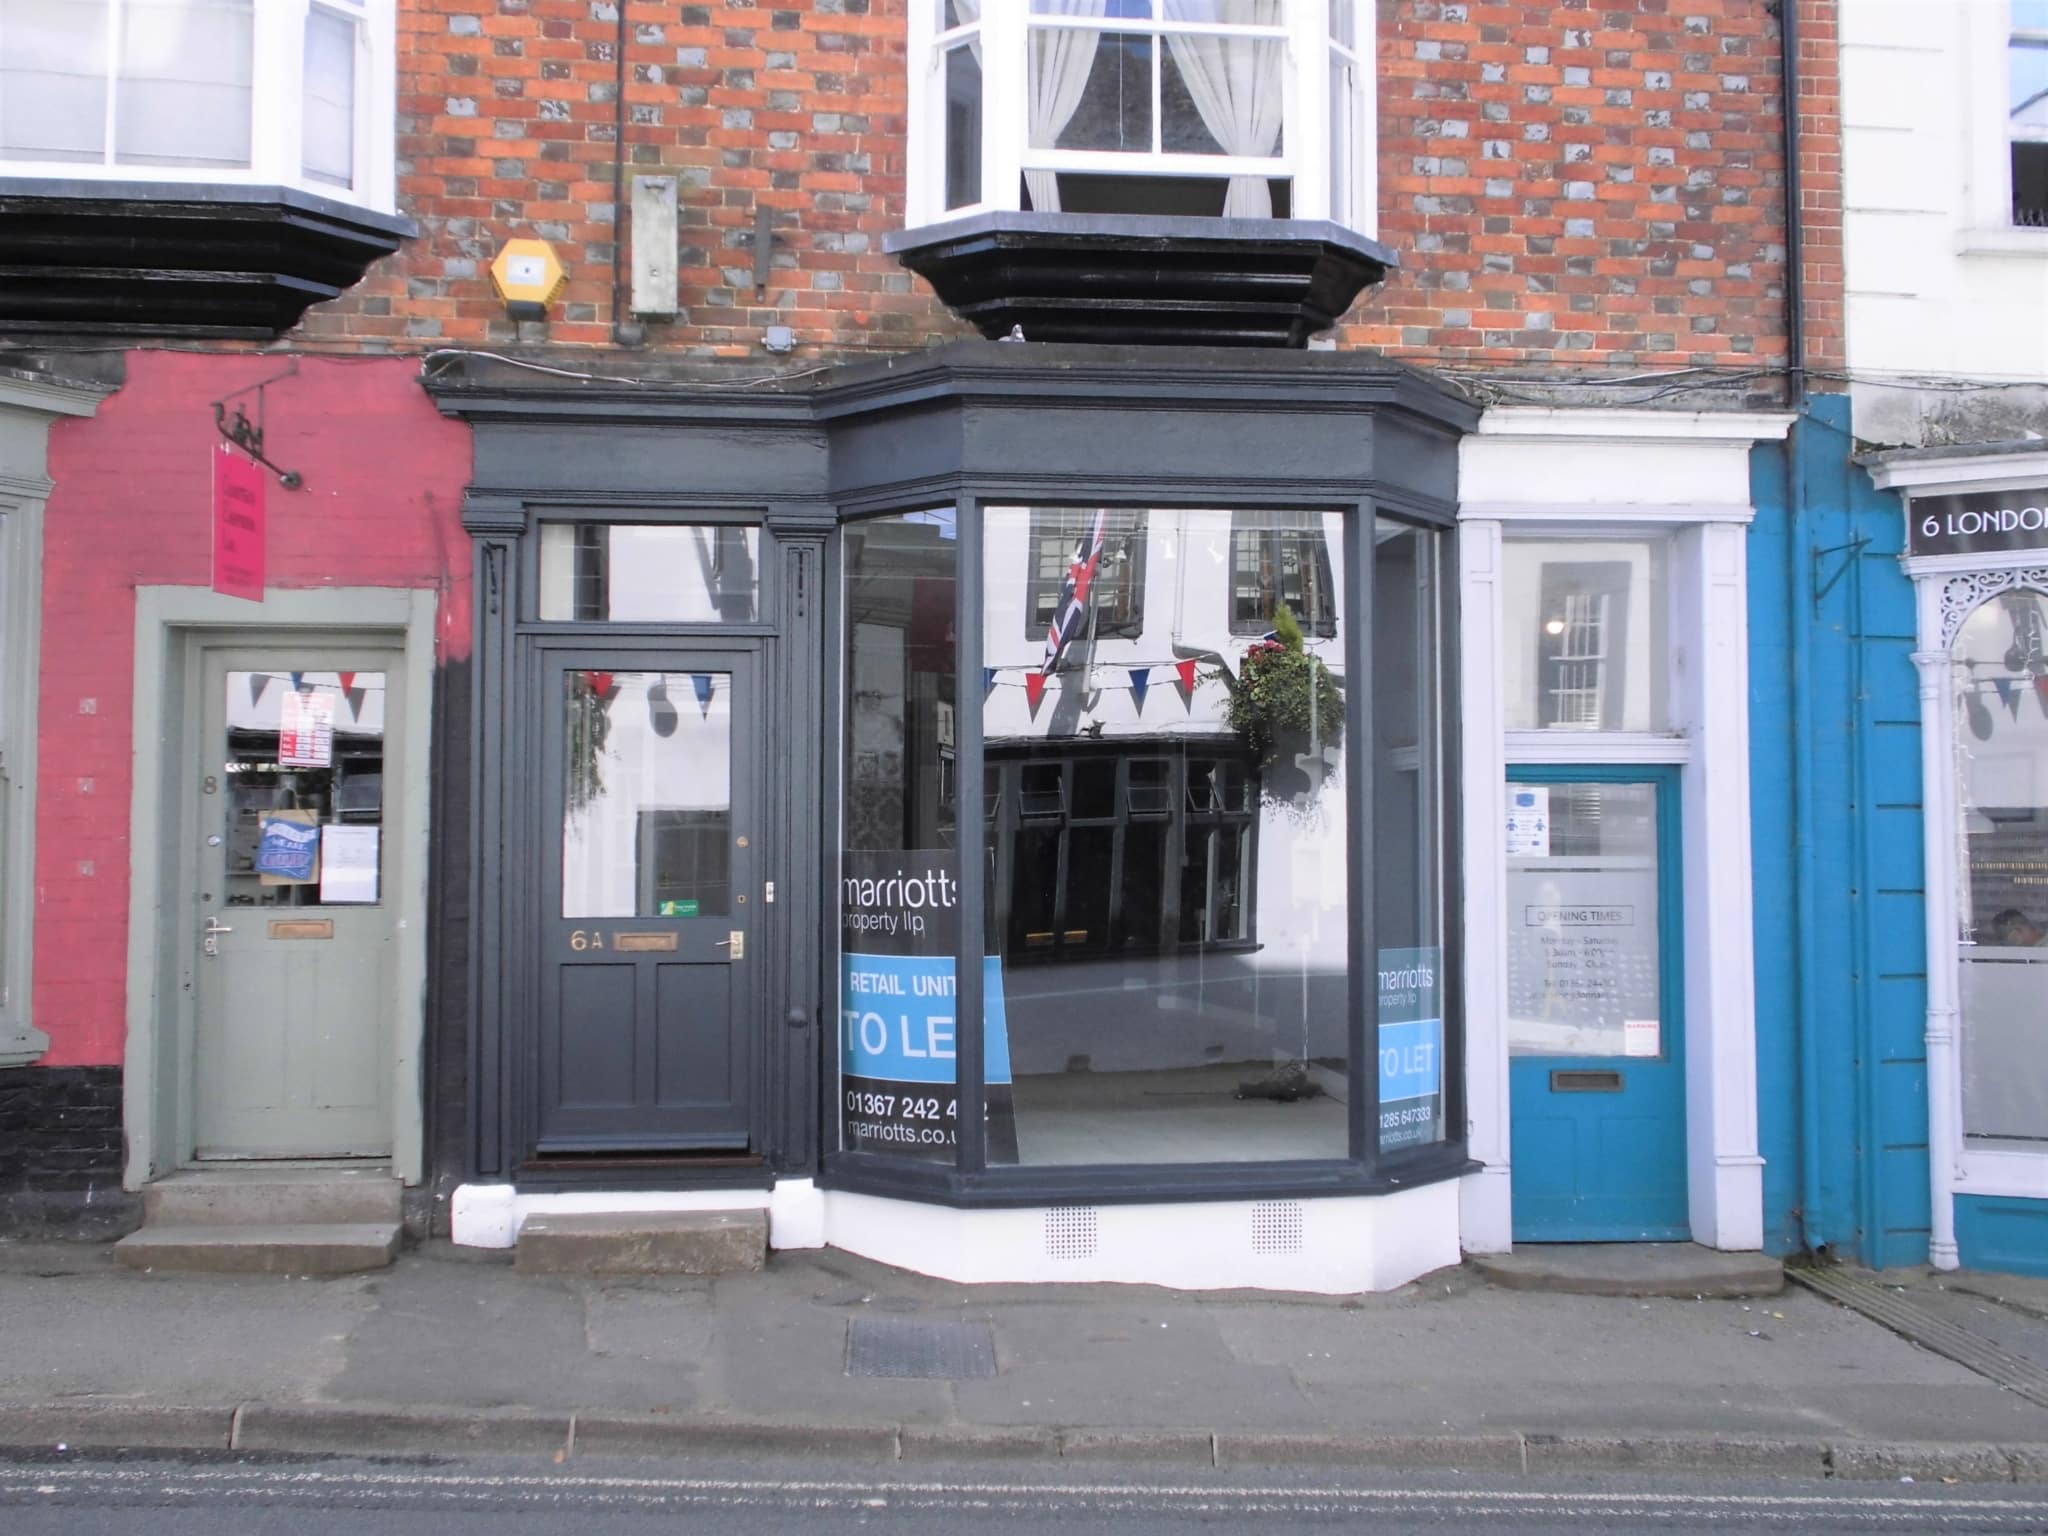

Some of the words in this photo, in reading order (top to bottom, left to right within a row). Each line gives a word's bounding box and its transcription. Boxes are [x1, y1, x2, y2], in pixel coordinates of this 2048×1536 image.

[1922, 515, 1940, 537] 6
[1947, 507, 2048, 535] LONDO
[203, 776, 217, 795] 8
[842, 911, 898, 936] property
[1590, 910, 1623, 922] TIMES
[850, 971, 906, 996] RETAIL
[1378, 963, 1433, 990] marriotts
[842, 1009, 887, 1056] TO
[901, 1014, 957, 1059] LE
[1403, 1043, 1434, 1074] LET
[847, 1090, 896, 1117] 01367
[902, 1096, 940, 1120] 242
[848, 1120, 956, 1144] marriotts.co.
